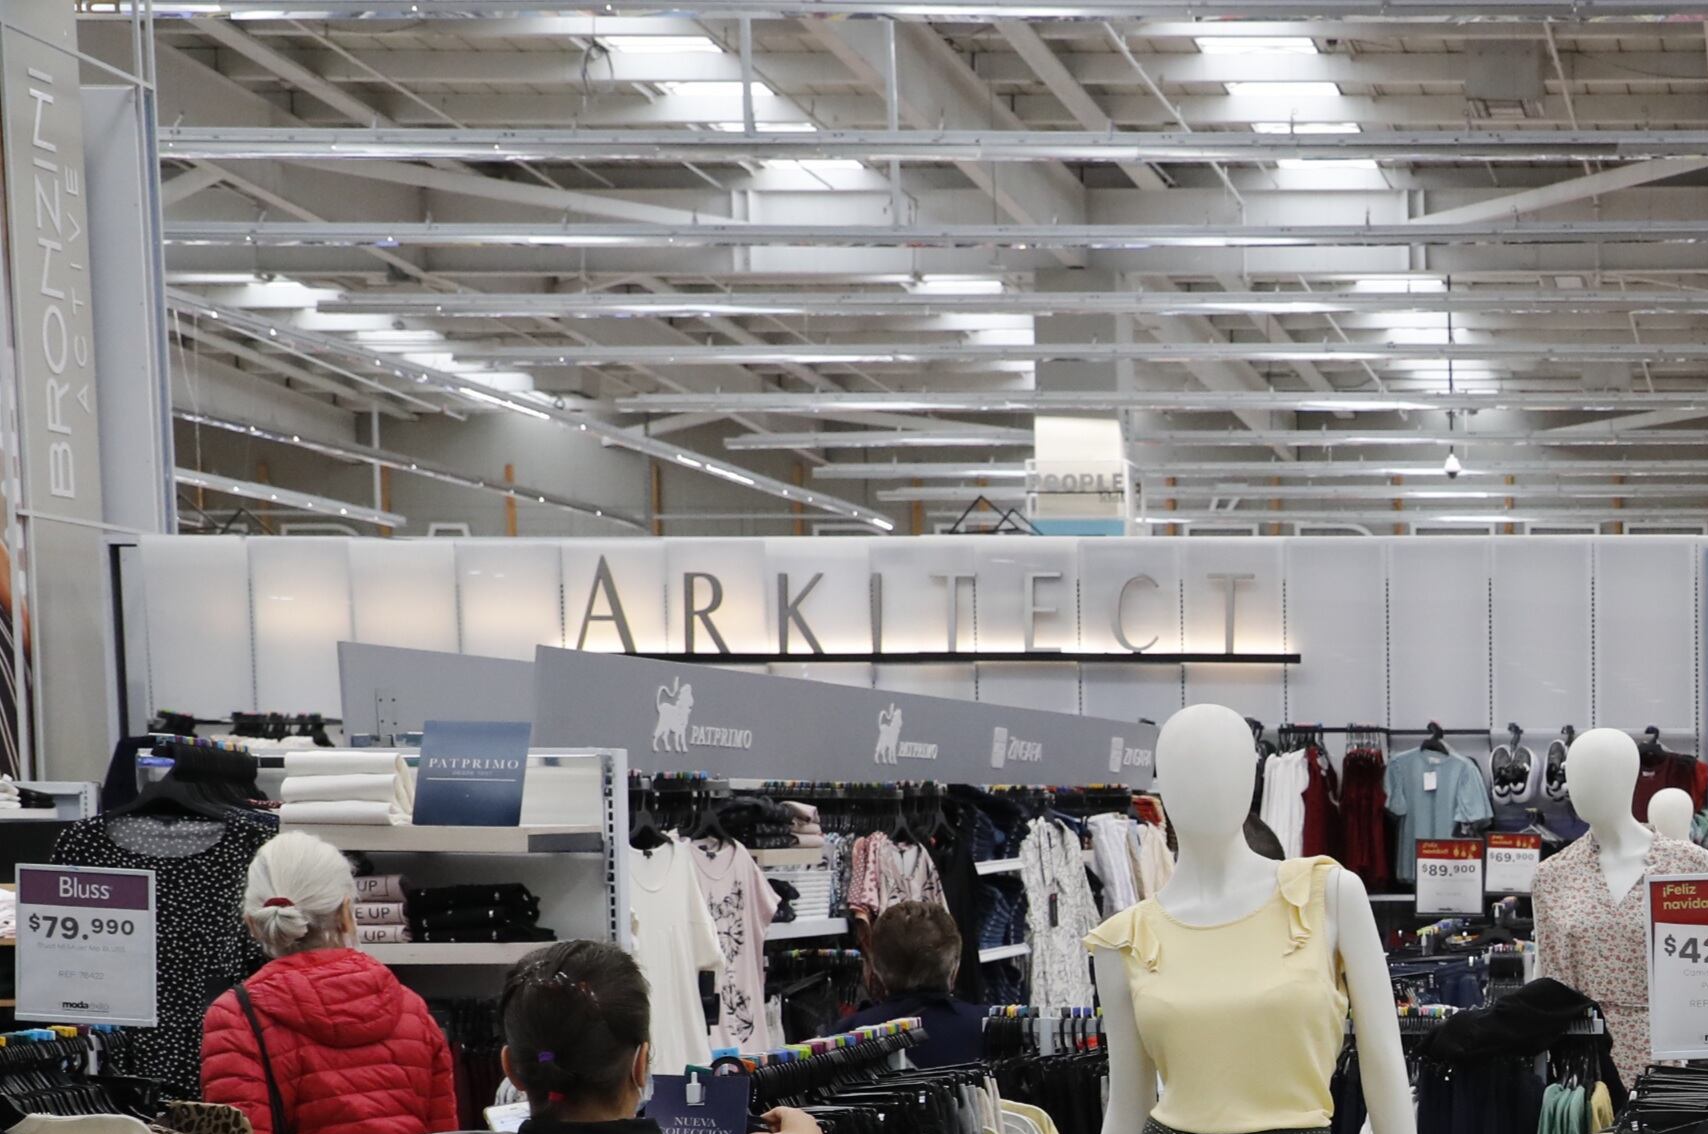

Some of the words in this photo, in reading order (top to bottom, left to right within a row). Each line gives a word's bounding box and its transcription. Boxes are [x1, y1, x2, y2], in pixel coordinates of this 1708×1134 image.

[28, 67, 75, 501] BRONZINI
[63, 164, 92, 415] ACTIVE
[575, 554, 1256, 656] ARKITECT
[690, 725, 753, 749] PATPRIMO
[428, 757, 520, 770] PATPRIMO
[1489, 852, 1535, 862] $69.900
[1421, 863, 1476, 877] $89.900
[59, 876, 111, 901] Bluss
[356, 880, 378, 892] UP
[1662, 884, 1697, 896] ¡Feliz
[368, 907, 390, 920] UP
[28, 912, 135, 941] $79.990
[364, 930, 387, 942] UP
[674, 1116, 717, 1127] NUEVA
